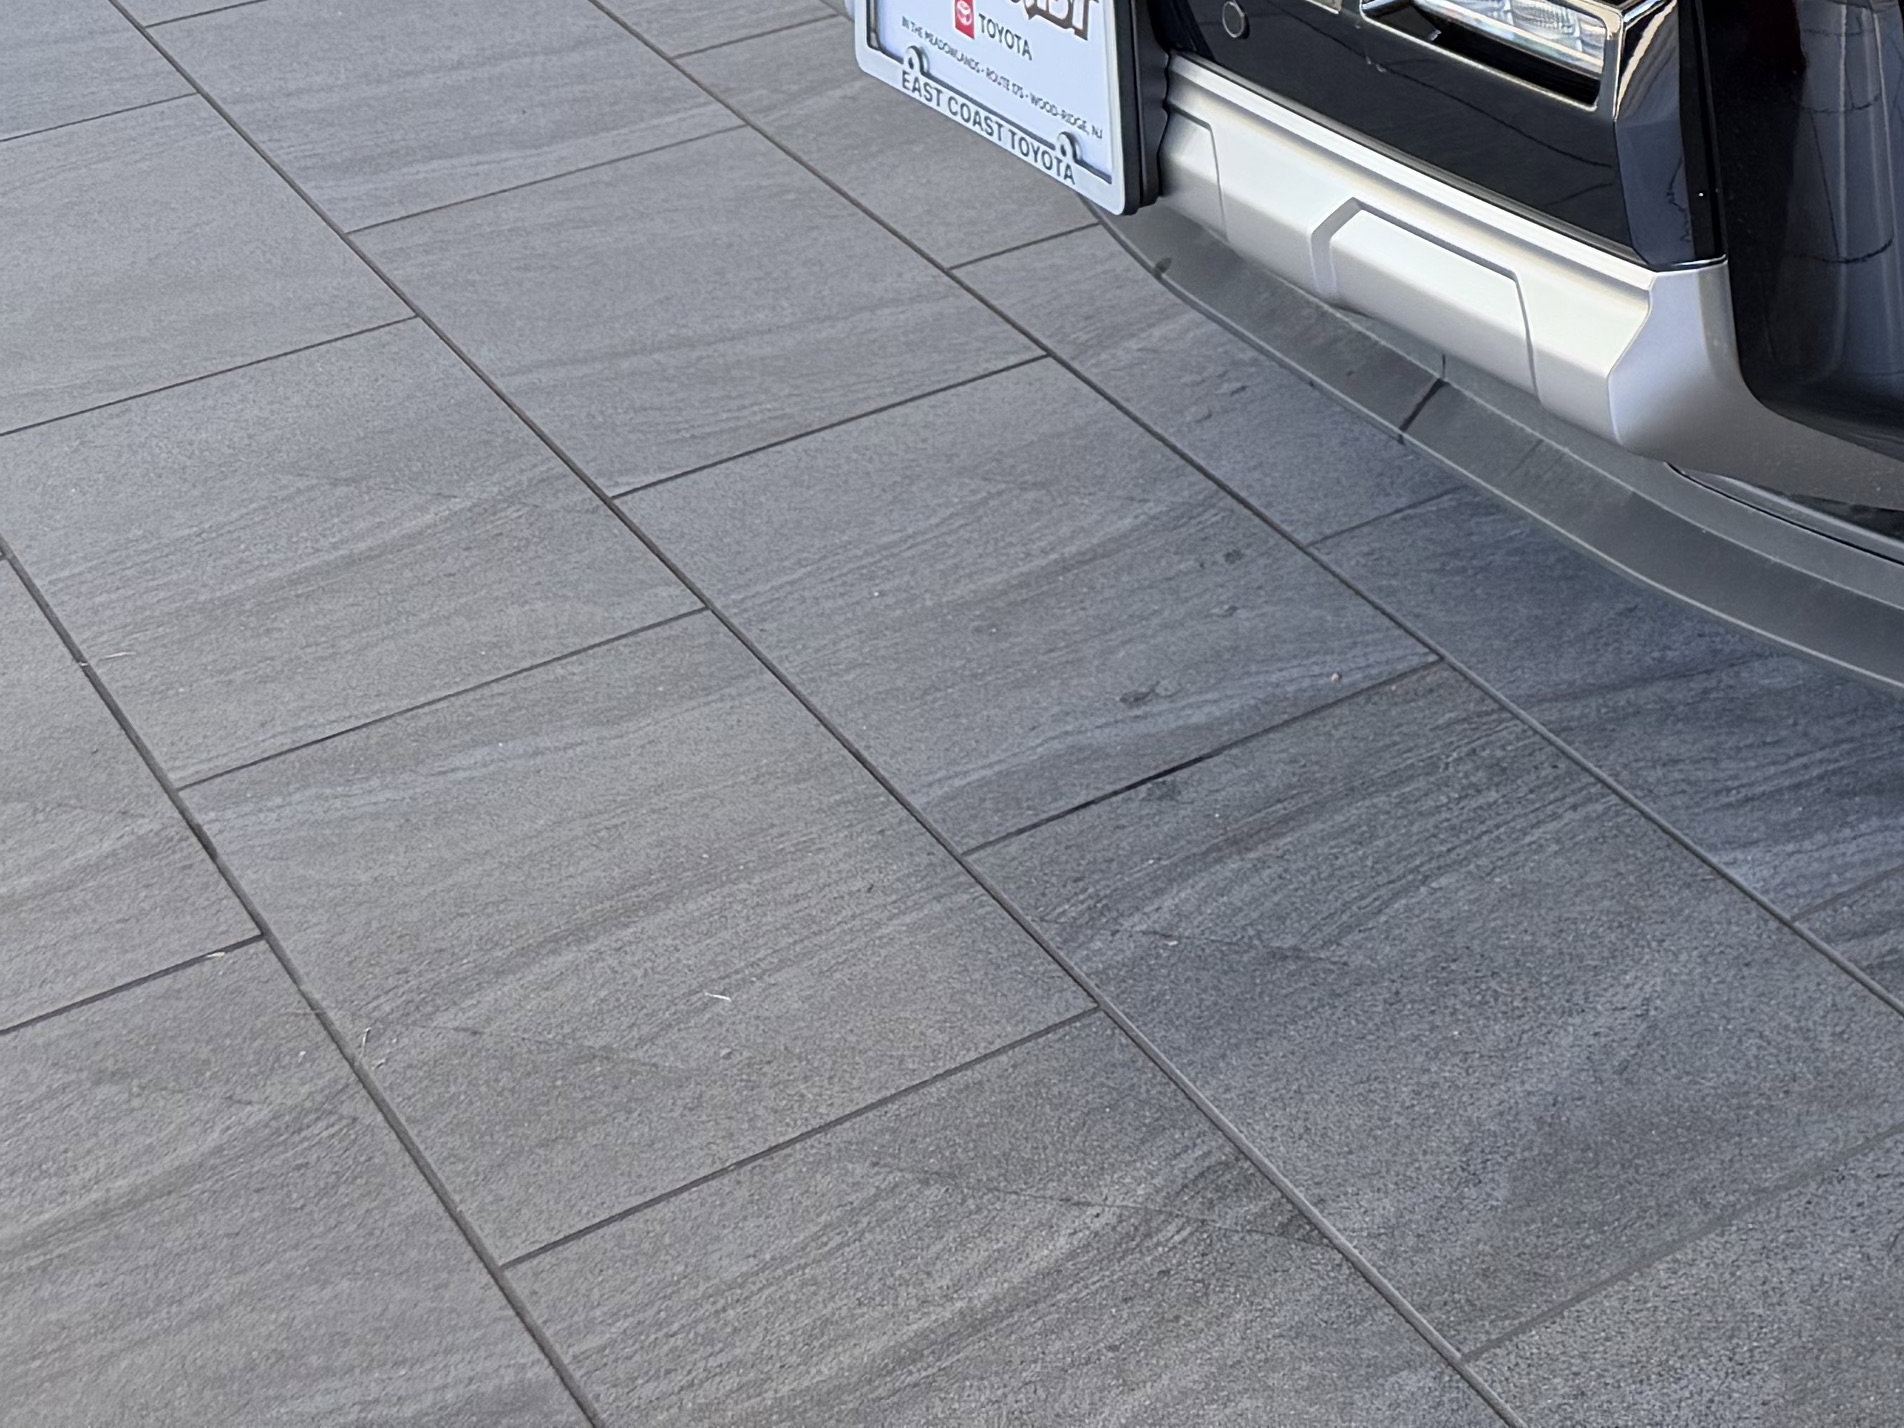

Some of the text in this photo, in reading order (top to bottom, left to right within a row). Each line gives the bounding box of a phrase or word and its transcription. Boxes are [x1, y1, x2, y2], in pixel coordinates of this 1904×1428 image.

[979, 13, 1033, 61] TOYOTA
[902, 69, 1076, 185] EAST COAST TOYOTA
